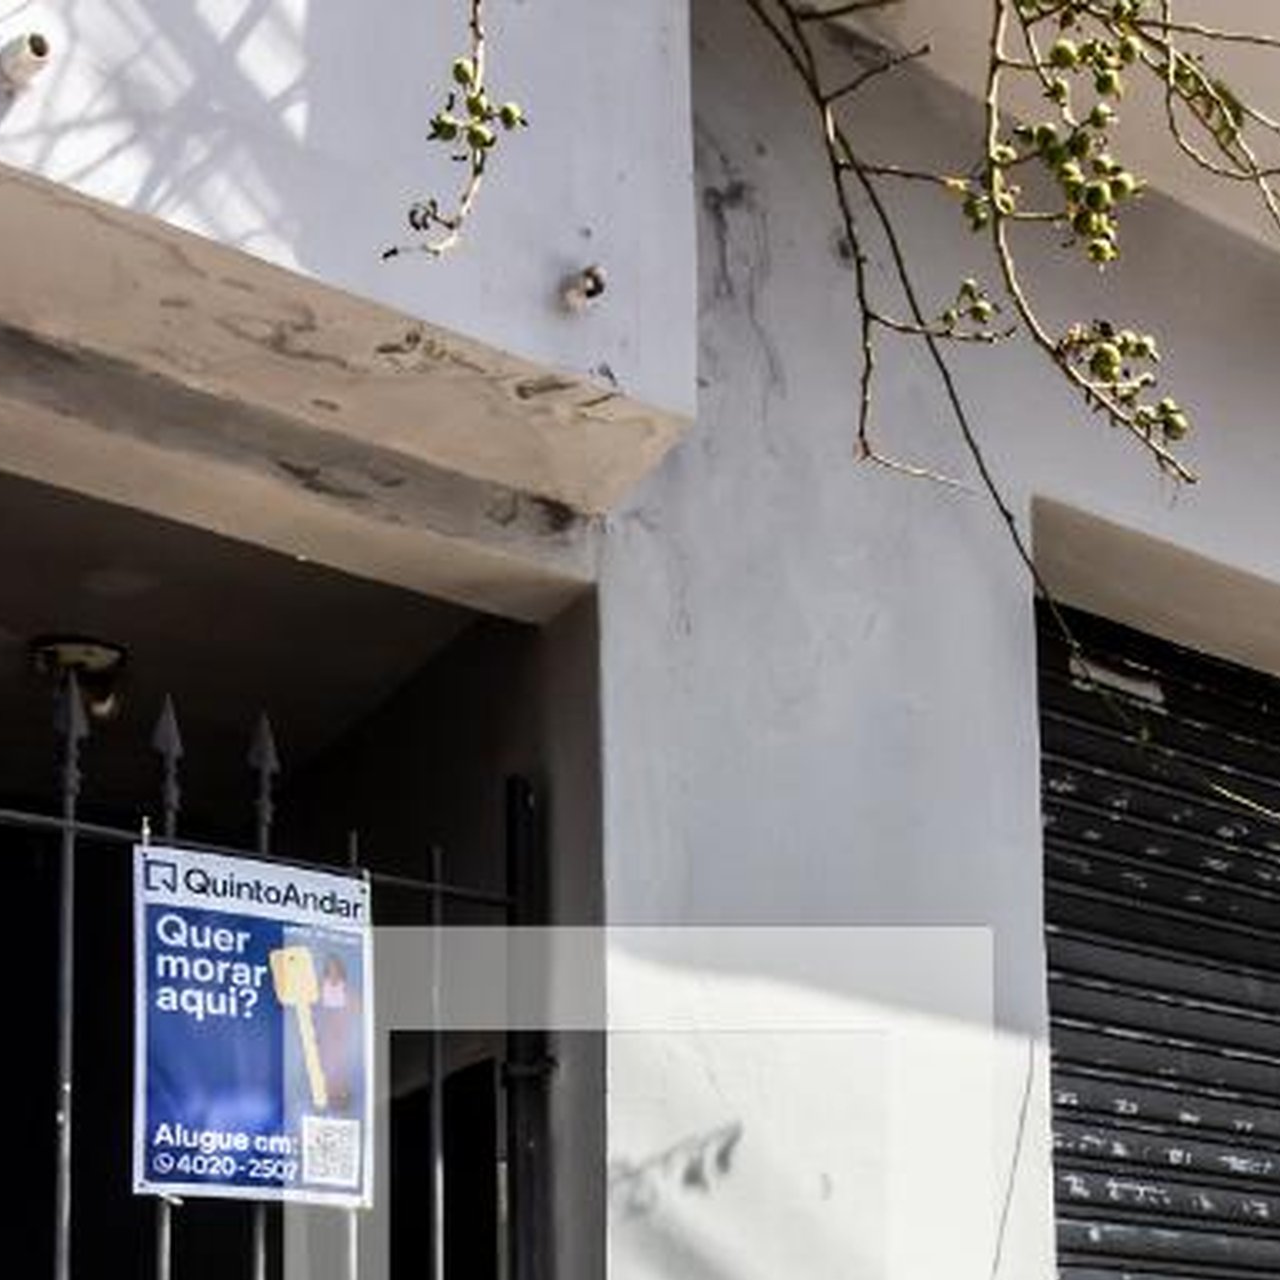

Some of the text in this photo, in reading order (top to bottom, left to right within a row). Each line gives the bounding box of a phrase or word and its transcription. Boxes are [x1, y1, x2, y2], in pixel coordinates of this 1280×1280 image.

[184, 868, 363, 918] QuintoAndar
[156, 914, 251, 953] Quer
[156, 951, 268, 987] morar
[156, 985, 259, 1022] aqui?
[154, 1123, 250, 1154] Alugue
